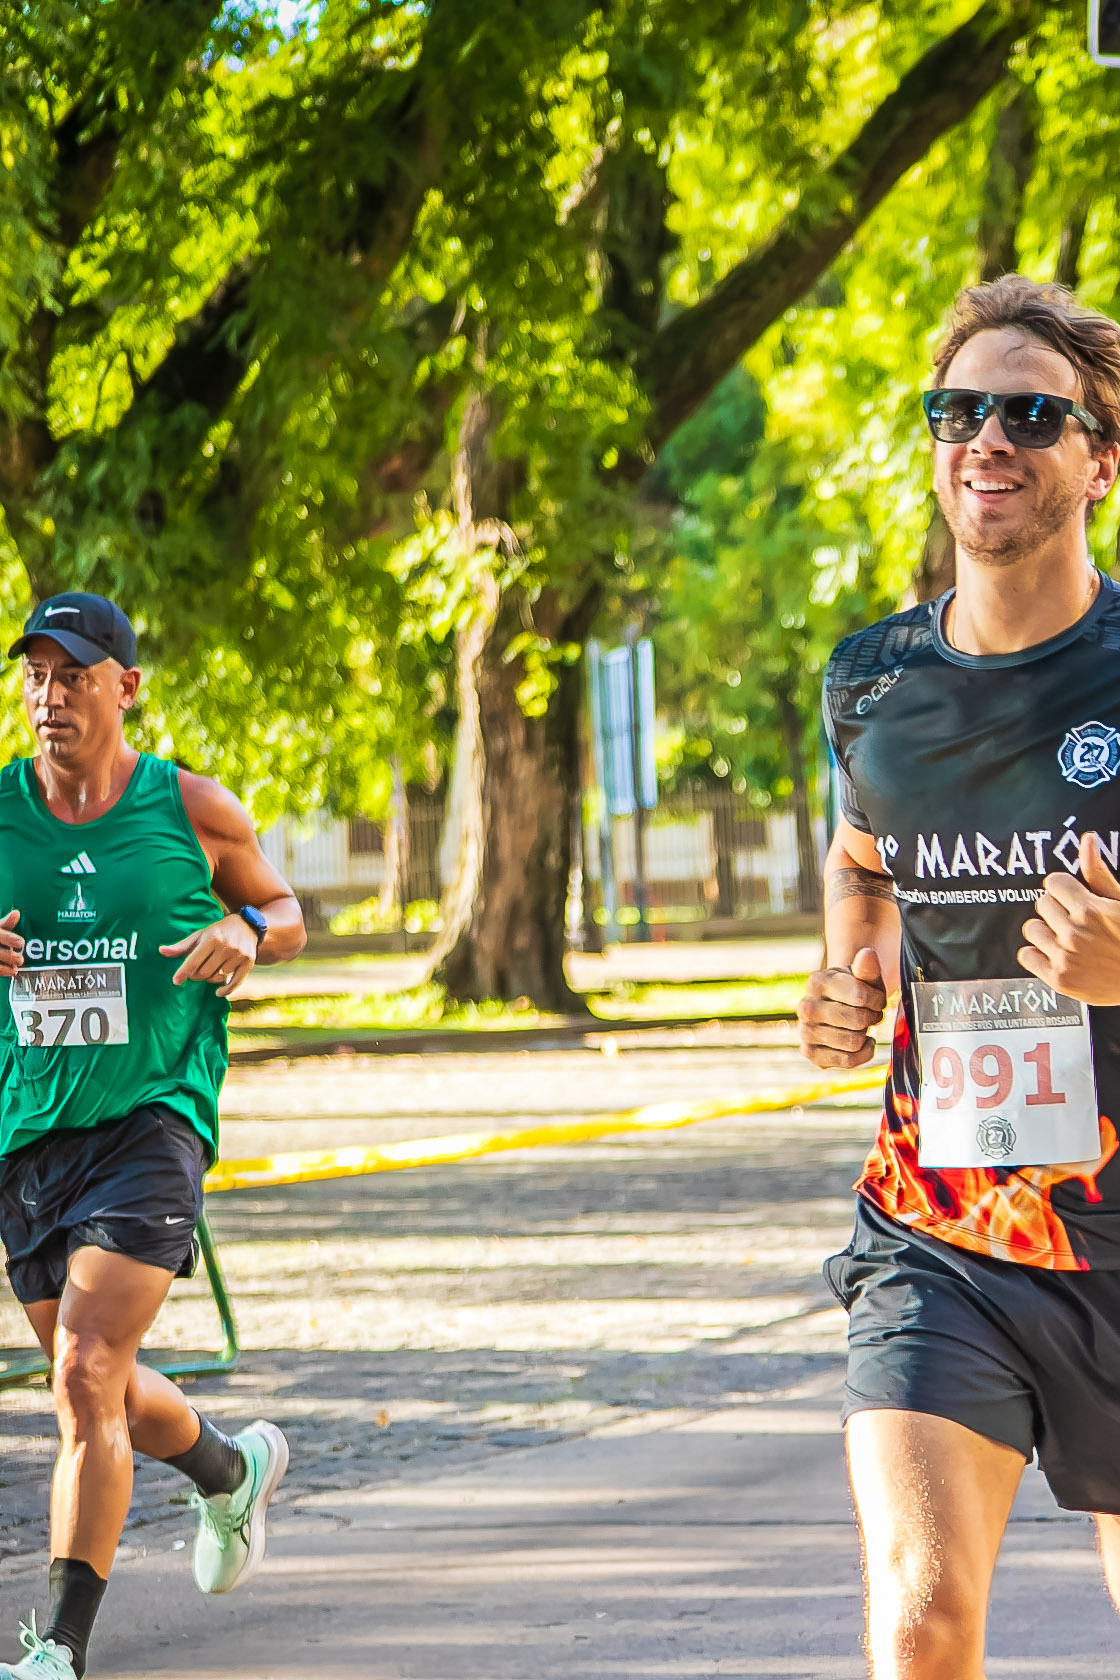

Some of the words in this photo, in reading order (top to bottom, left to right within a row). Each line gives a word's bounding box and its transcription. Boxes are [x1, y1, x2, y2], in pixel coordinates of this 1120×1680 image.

[1080, 742, 1105, 763] 27
[915, 815, 1119, 878] MARATÓN
[930, 889, 997, 905] BOMBEROS
[998, 888, 1049, 903] VOLUNT
[20, 930, 138, 961] ersonal
[34, 970, 107, 992] MARATÓN
[950, 983, 1059, 1016] MARATÓN
[20, 1007, 110, 1047] 370
[931, 1042, 1067, 1110] 991
